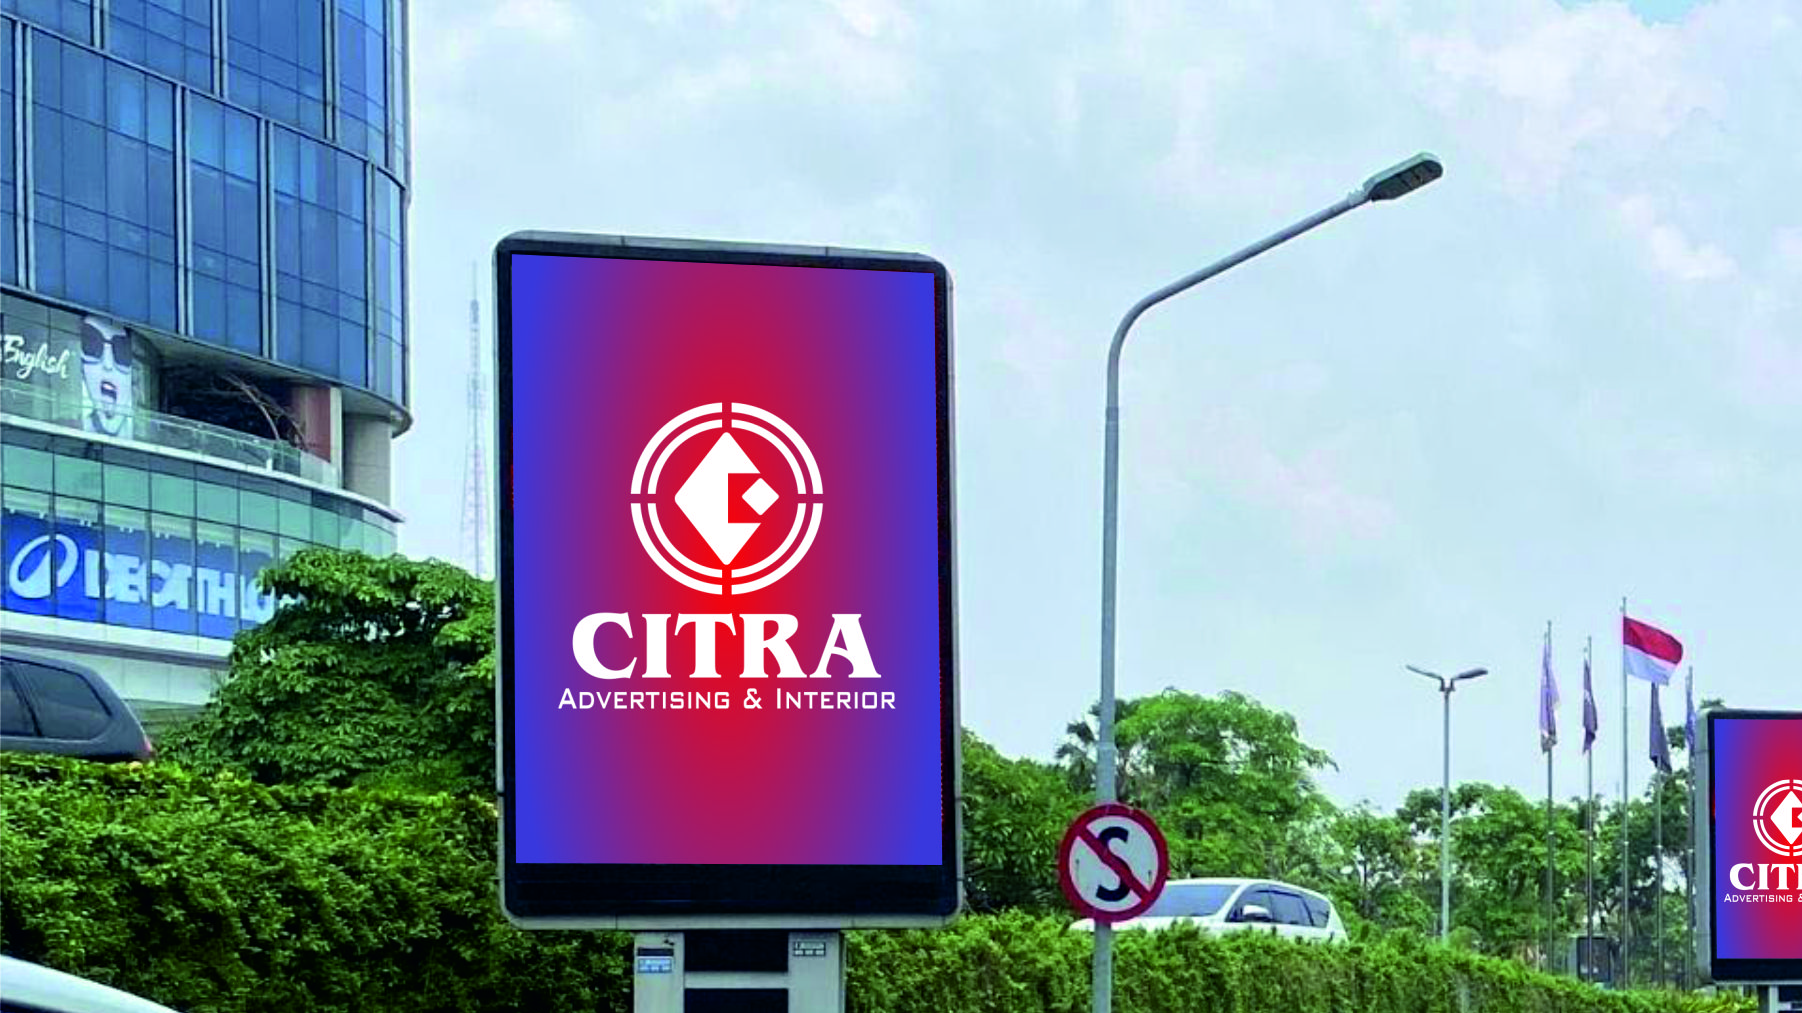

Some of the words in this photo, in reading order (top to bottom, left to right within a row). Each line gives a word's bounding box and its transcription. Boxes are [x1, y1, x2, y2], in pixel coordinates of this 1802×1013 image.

[84, 549, 305, 624] DECATHLO
[572, 612, 882, 680] CITRA
[743, 687, 763, 710] &
[1096, 825, 1130, 903] S
